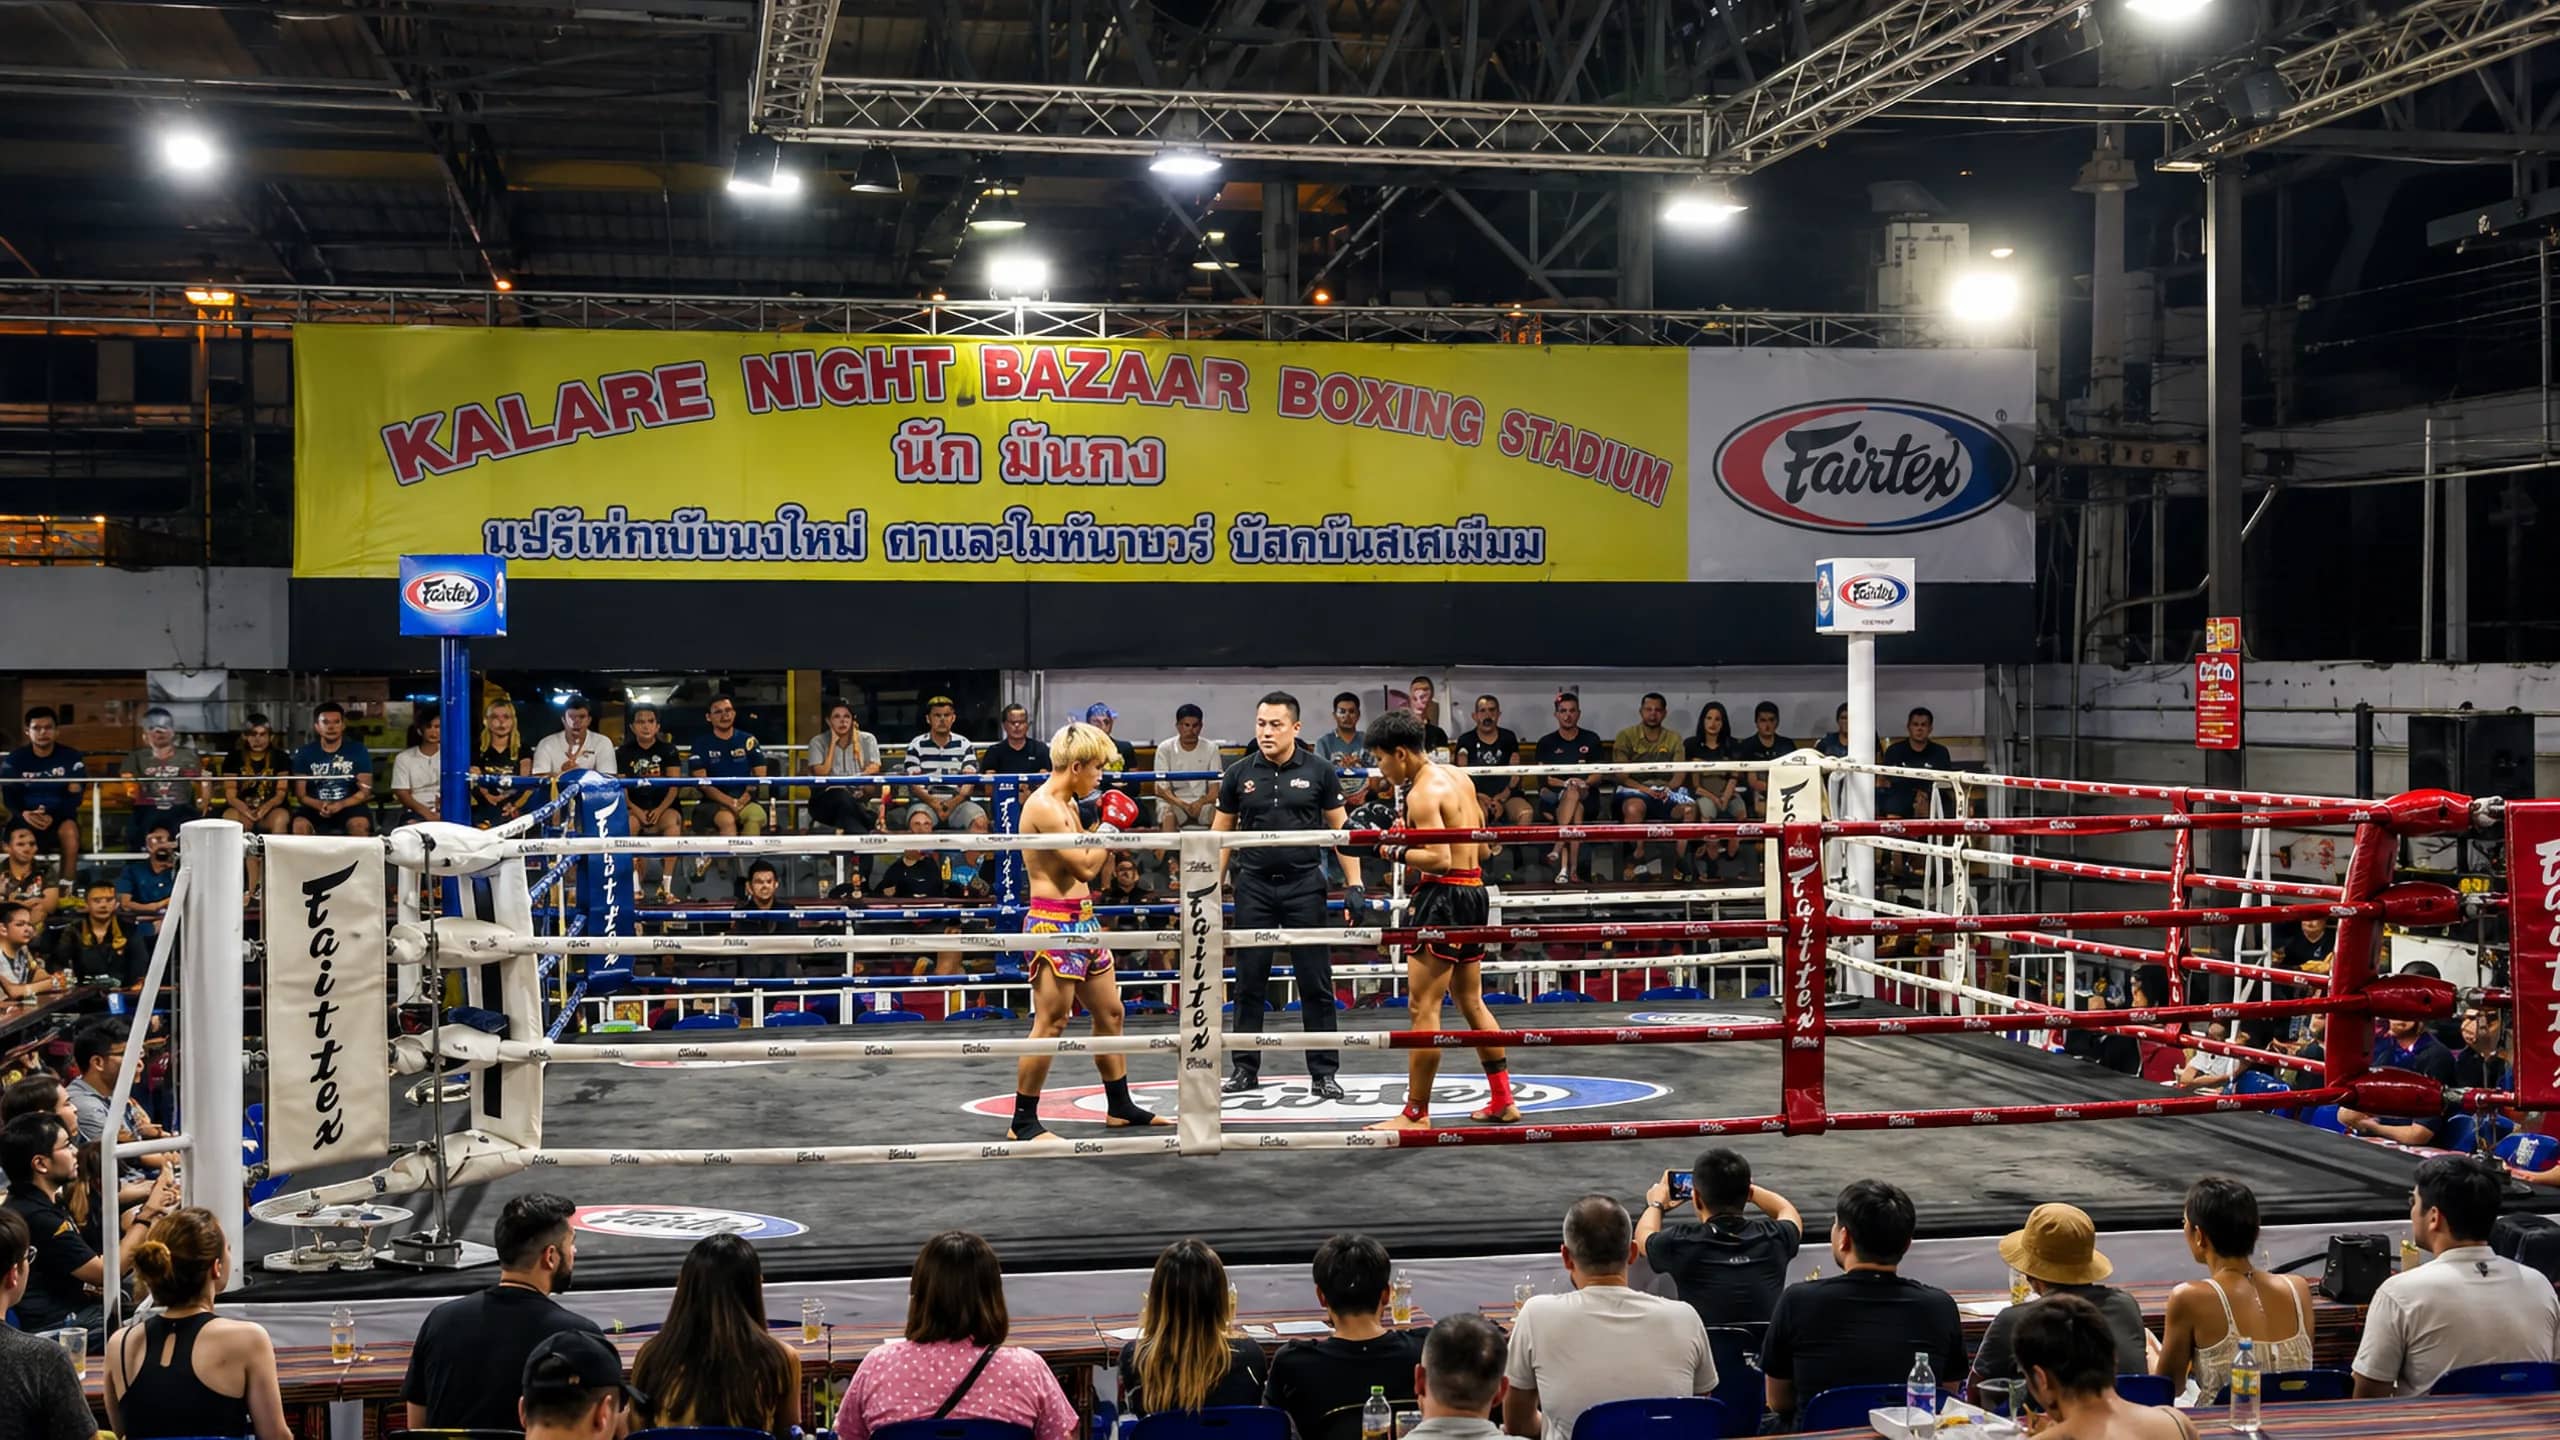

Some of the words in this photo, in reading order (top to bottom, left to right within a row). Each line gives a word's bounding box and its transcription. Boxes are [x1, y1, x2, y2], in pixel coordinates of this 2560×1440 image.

[381, 361, 714, 486] KALARE
[741, 345, 955, 414] NIGHT
[979, 343, 1249, 413] BAZAAR
[1278, 365, 1484, 447] BOXING
[1499, 409, 1673, 507] STADIUM
[1784, 421, 1960, 504] Fairtex
